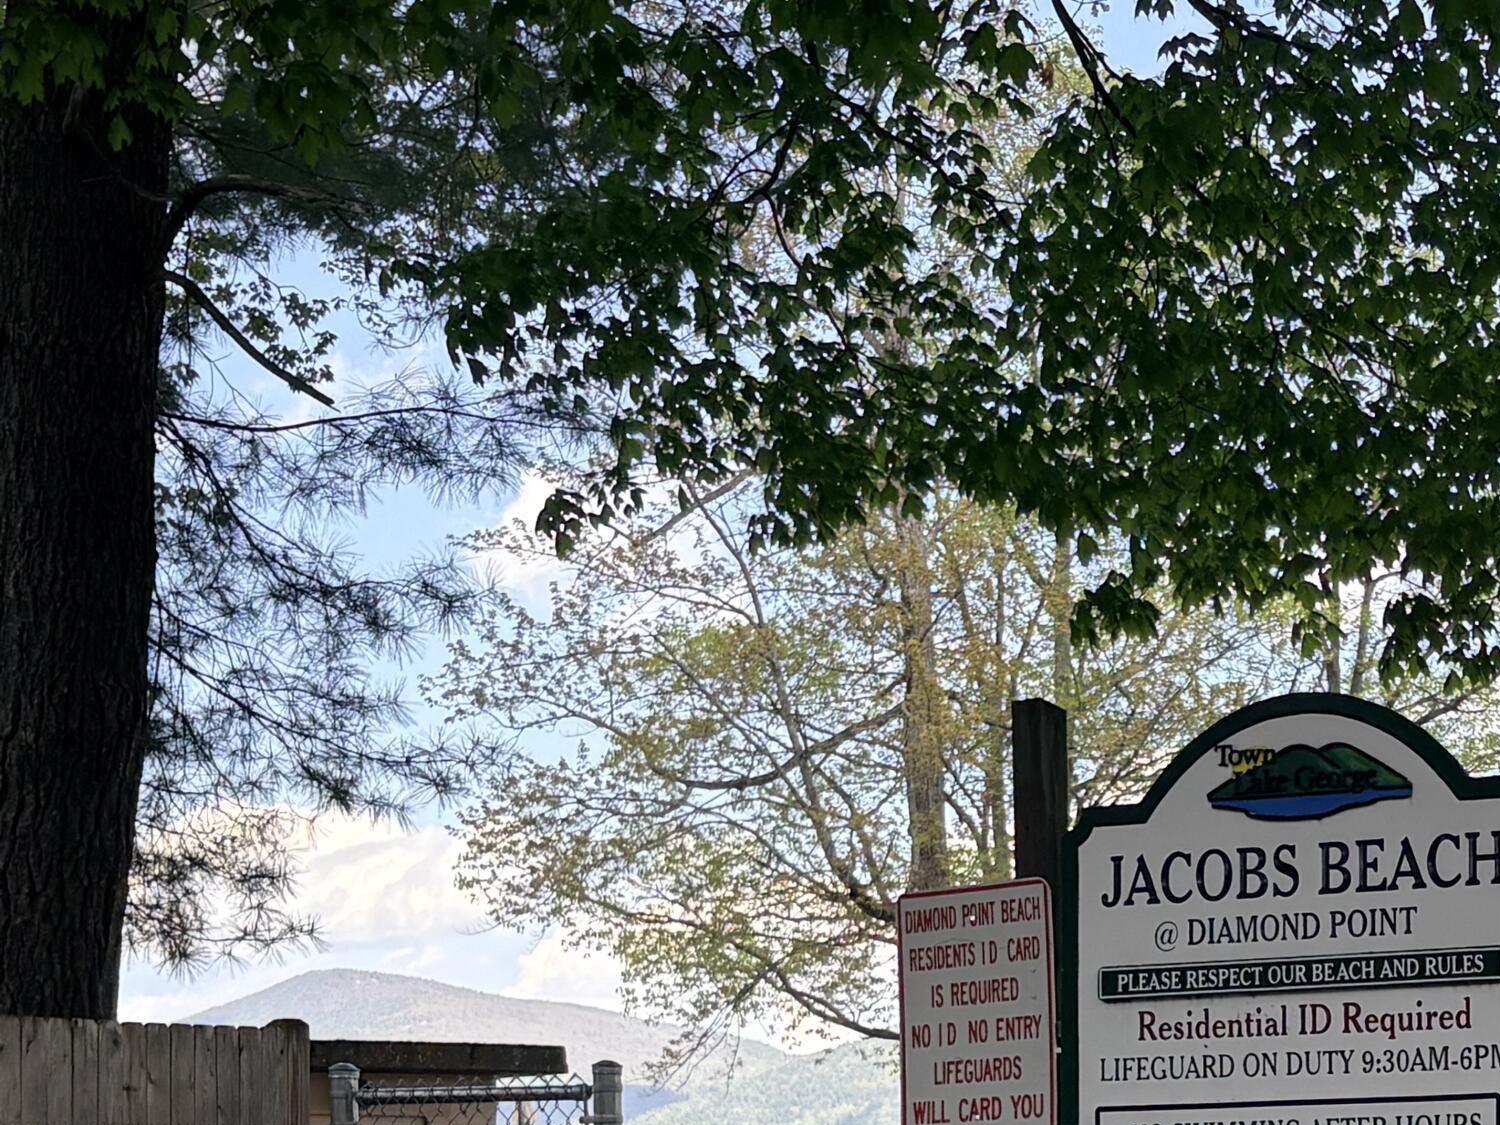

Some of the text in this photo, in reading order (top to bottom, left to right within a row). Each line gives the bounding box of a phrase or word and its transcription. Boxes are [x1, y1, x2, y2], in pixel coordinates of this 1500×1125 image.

[1214, 744, 1276, 767] Town
[1294, 766, 1377, 794] George
[1101, 844, 1300, 907] JACOBS
[905, 896, 1041, 934] DIAMOND POINT BEACH
[1154, 907, 1418, 951] @ DIAMOND POINT
[909, 942, 976, 972] RESIDENTS
[1008, 936, 1040, 962] CARD
[1117, 955, 1484, 993] PLEASE RESPECT OUR BEACH AND RULES
[931, 977, 1019, 1008] IS REQUIRED
[912, 1025, 931, 1049] NO
[968, 1019, 988, 1044] NO
[996, 1014, 1042, 1042] ENTRY
[1138, 997, 1472, 1042] Residential ID Required
[934, 1056, 1022, 1085] LIFEGUARDS
[1100, 1052, 1235, 1082] LIFEGUARD
[1243, 1050, 1278, 1077] ON
[1285, 1048, 1355, 1076] DUTY
[913, 1094, 1044, 1125] WILL CARD YOU
